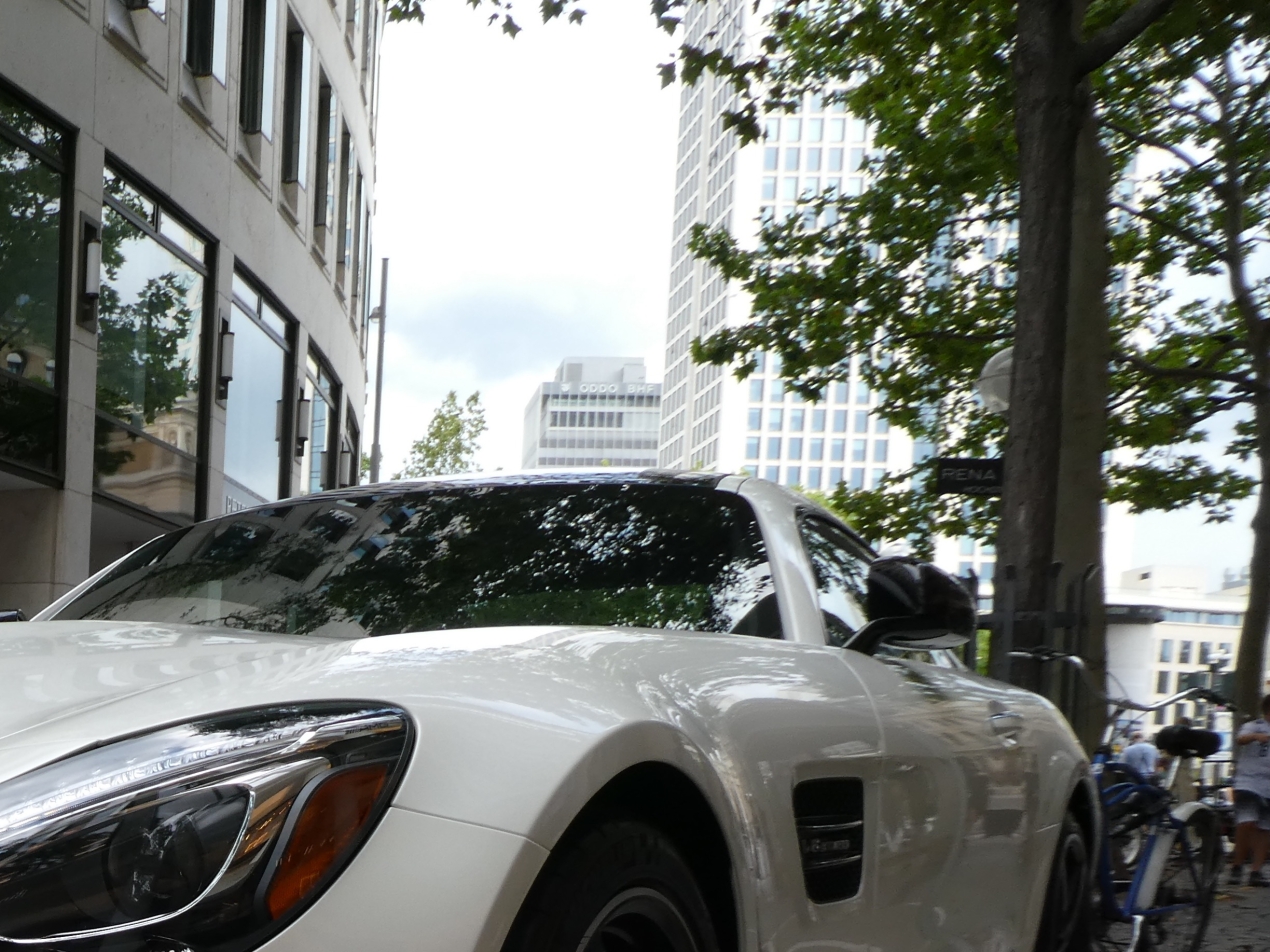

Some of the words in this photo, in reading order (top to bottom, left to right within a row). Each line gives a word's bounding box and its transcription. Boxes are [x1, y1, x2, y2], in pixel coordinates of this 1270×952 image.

[579, 383, 618, 394] ODDO
[627, 384, 655, 394] BHF
[941, 467, 997, 481] RENA
